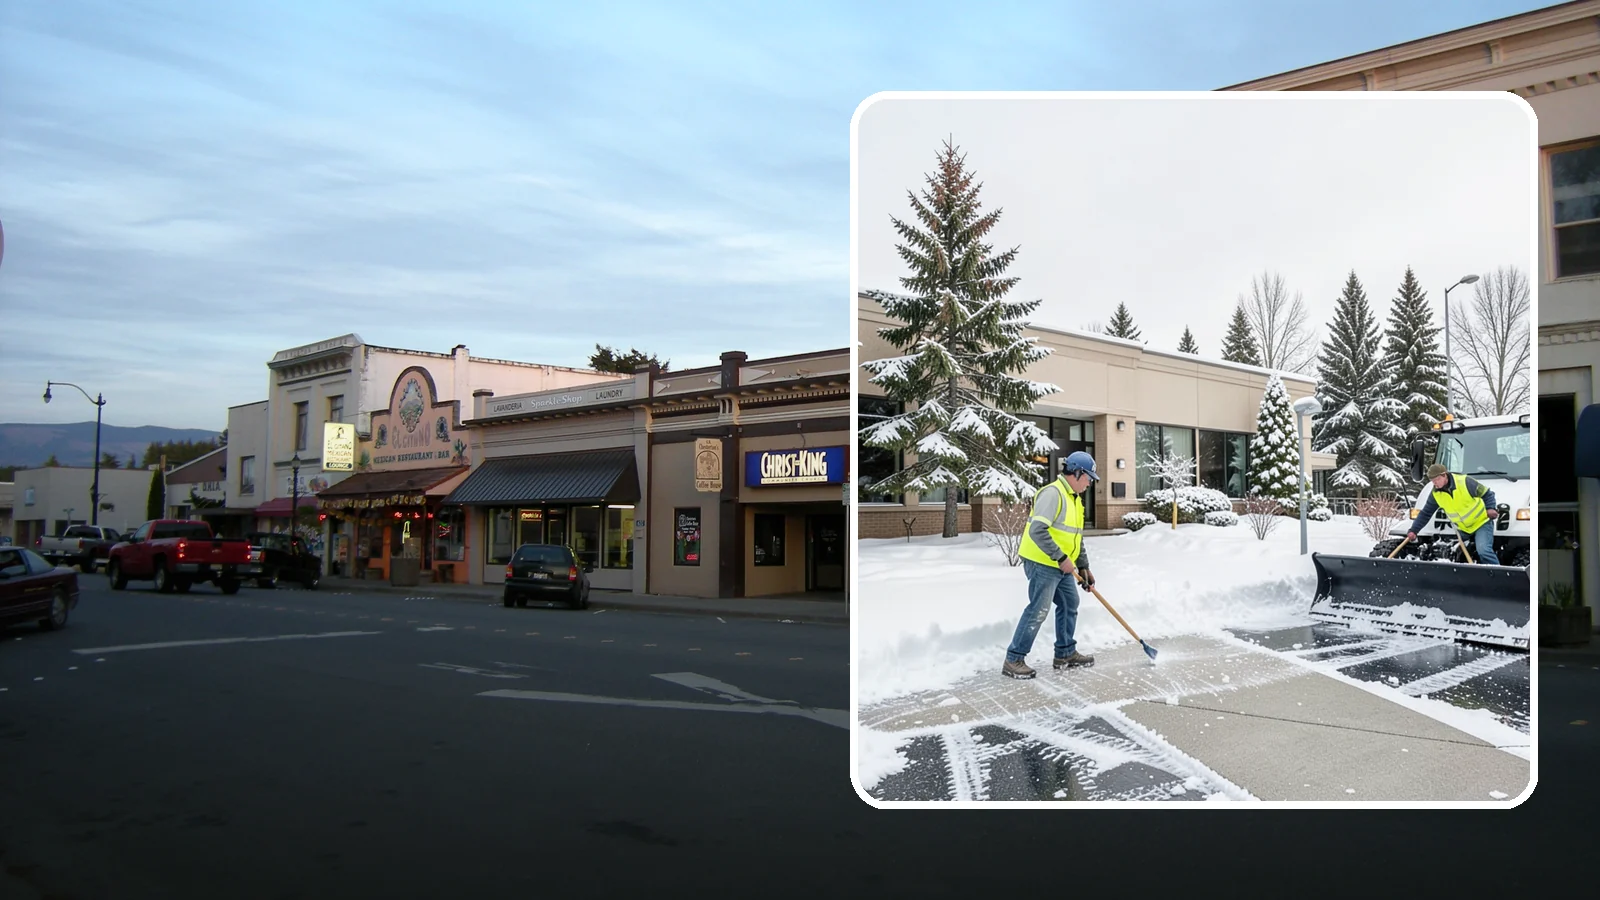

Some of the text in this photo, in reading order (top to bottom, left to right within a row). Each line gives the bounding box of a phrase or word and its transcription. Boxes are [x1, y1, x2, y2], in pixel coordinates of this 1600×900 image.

[494, 389, 623, 412] LAVANDERIA Sparkle Shop LAUNDRY
[374, 455, 396, 464] MEXICAN
[398, 452, 433, 462] RESTAURANT
[438, 450, 450, 459] BAR
